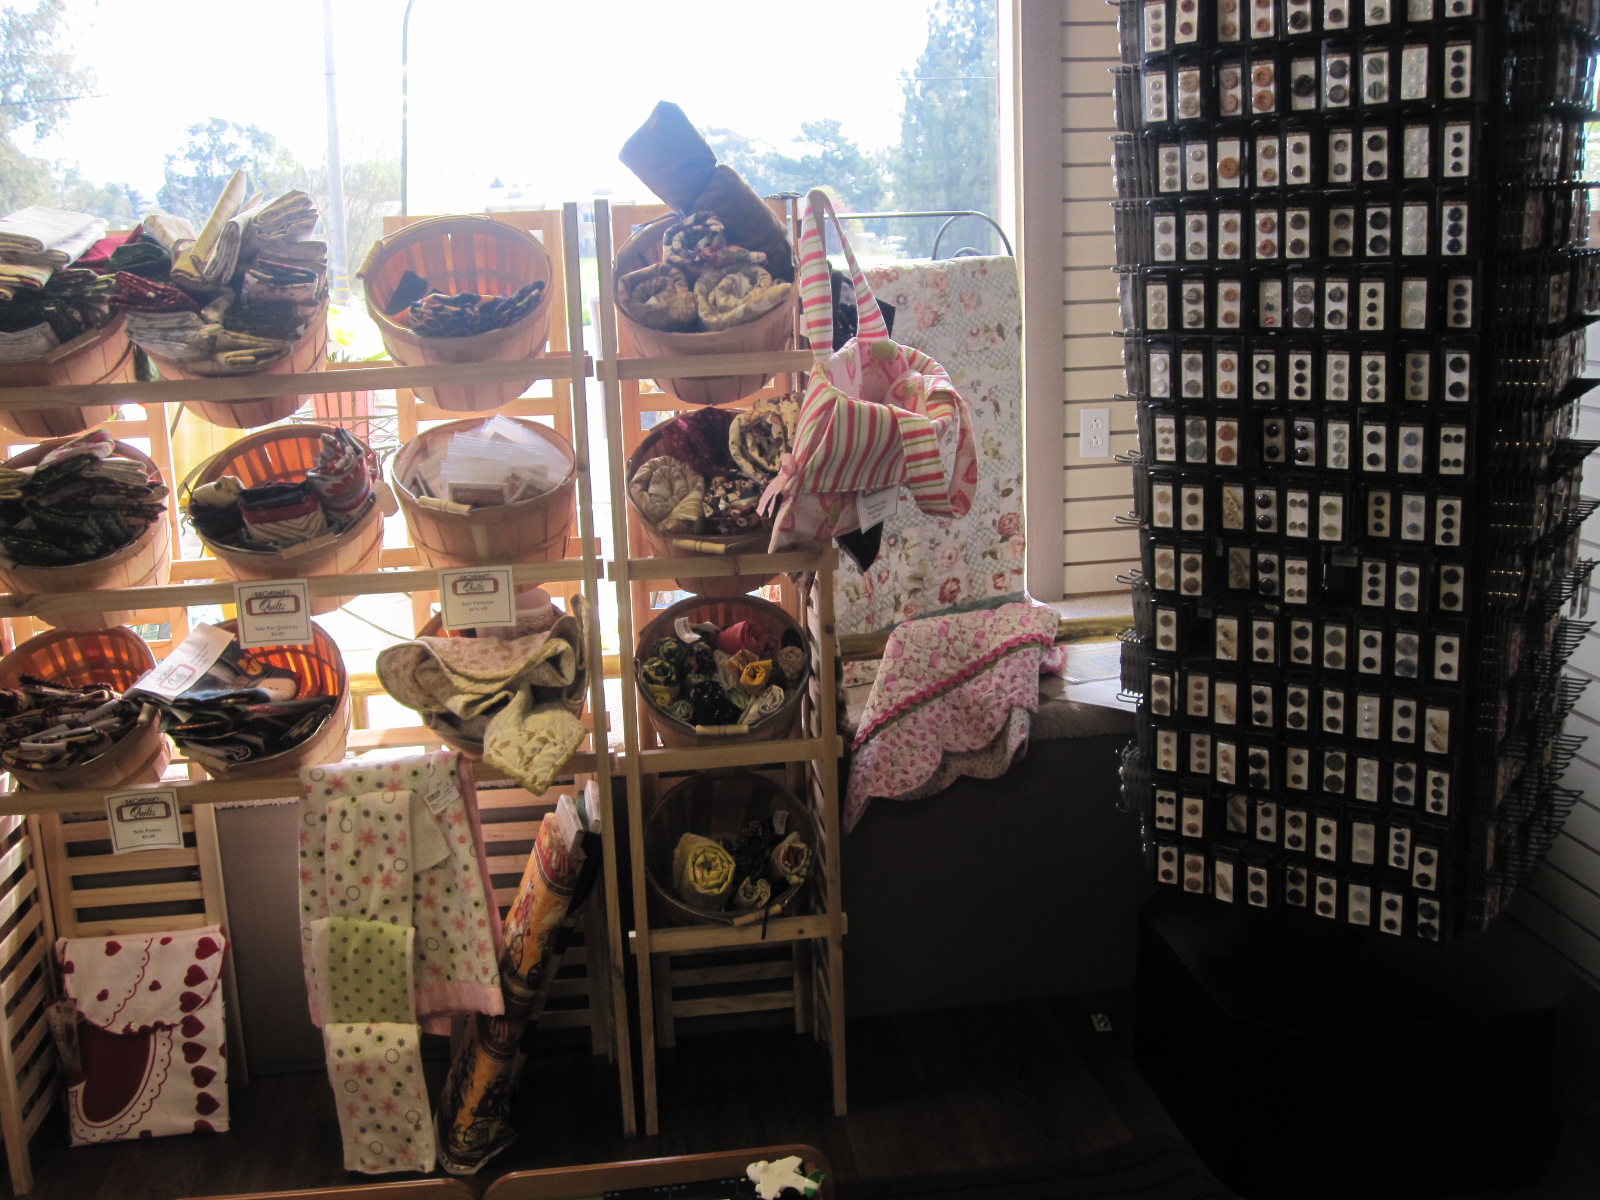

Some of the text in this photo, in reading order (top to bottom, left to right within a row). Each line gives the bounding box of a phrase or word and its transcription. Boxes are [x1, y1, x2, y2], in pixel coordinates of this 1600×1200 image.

[255, 589, 290, 597] BROADWAY
[463, 580, 485, 594] Quilts
[259, 598, 285, 613] Quilts
[125, 796, 160, 805] BROADWAY
[130, 805, 156, 819] Quilts
